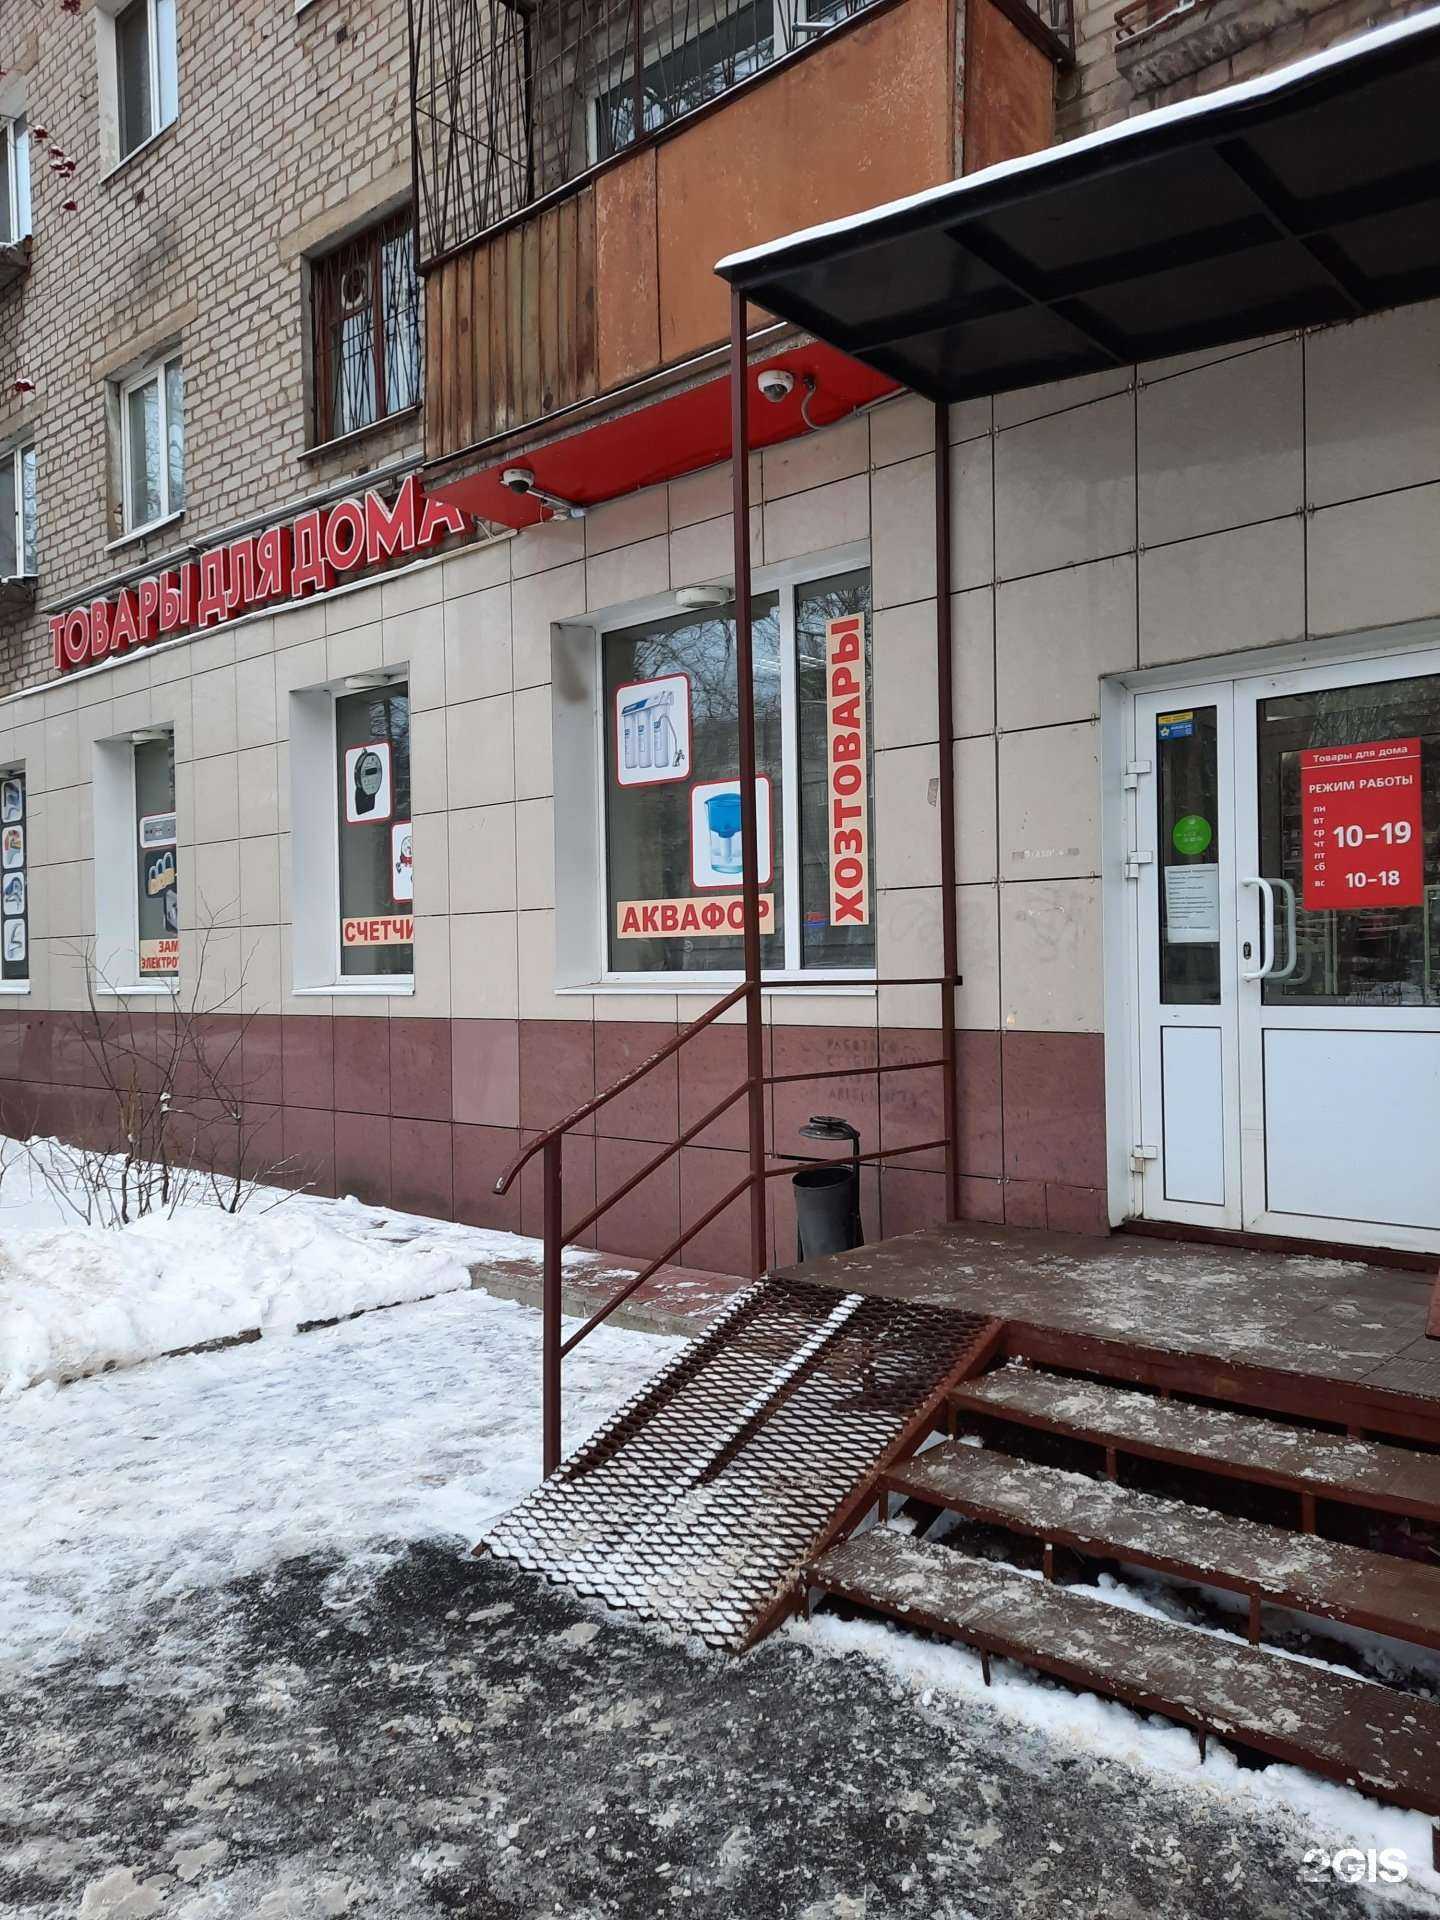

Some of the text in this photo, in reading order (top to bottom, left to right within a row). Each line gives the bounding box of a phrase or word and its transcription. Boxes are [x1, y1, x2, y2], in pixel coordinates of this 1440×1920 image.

[48, 474, 470, 671] ТОВАРЫ ДЛЯ ДОМА
[1313, 746, 1408, 763] Товары для дома
[831, 618, 864, 923] ХОЗТОВАРЫ
[1309, 775, 1413, 794] РЕЖИМ РАБОТЫ
[1313, 817, 1325, 825] вт
[1313, 829, 1325, 838] ср
[1313, 840, 1325, 848] чт
[1314, 852, 1325, 860] пт
[1314, 862, 1326, 871] сб
[141, 956, 179, 969] ЭЛЕКТРО
